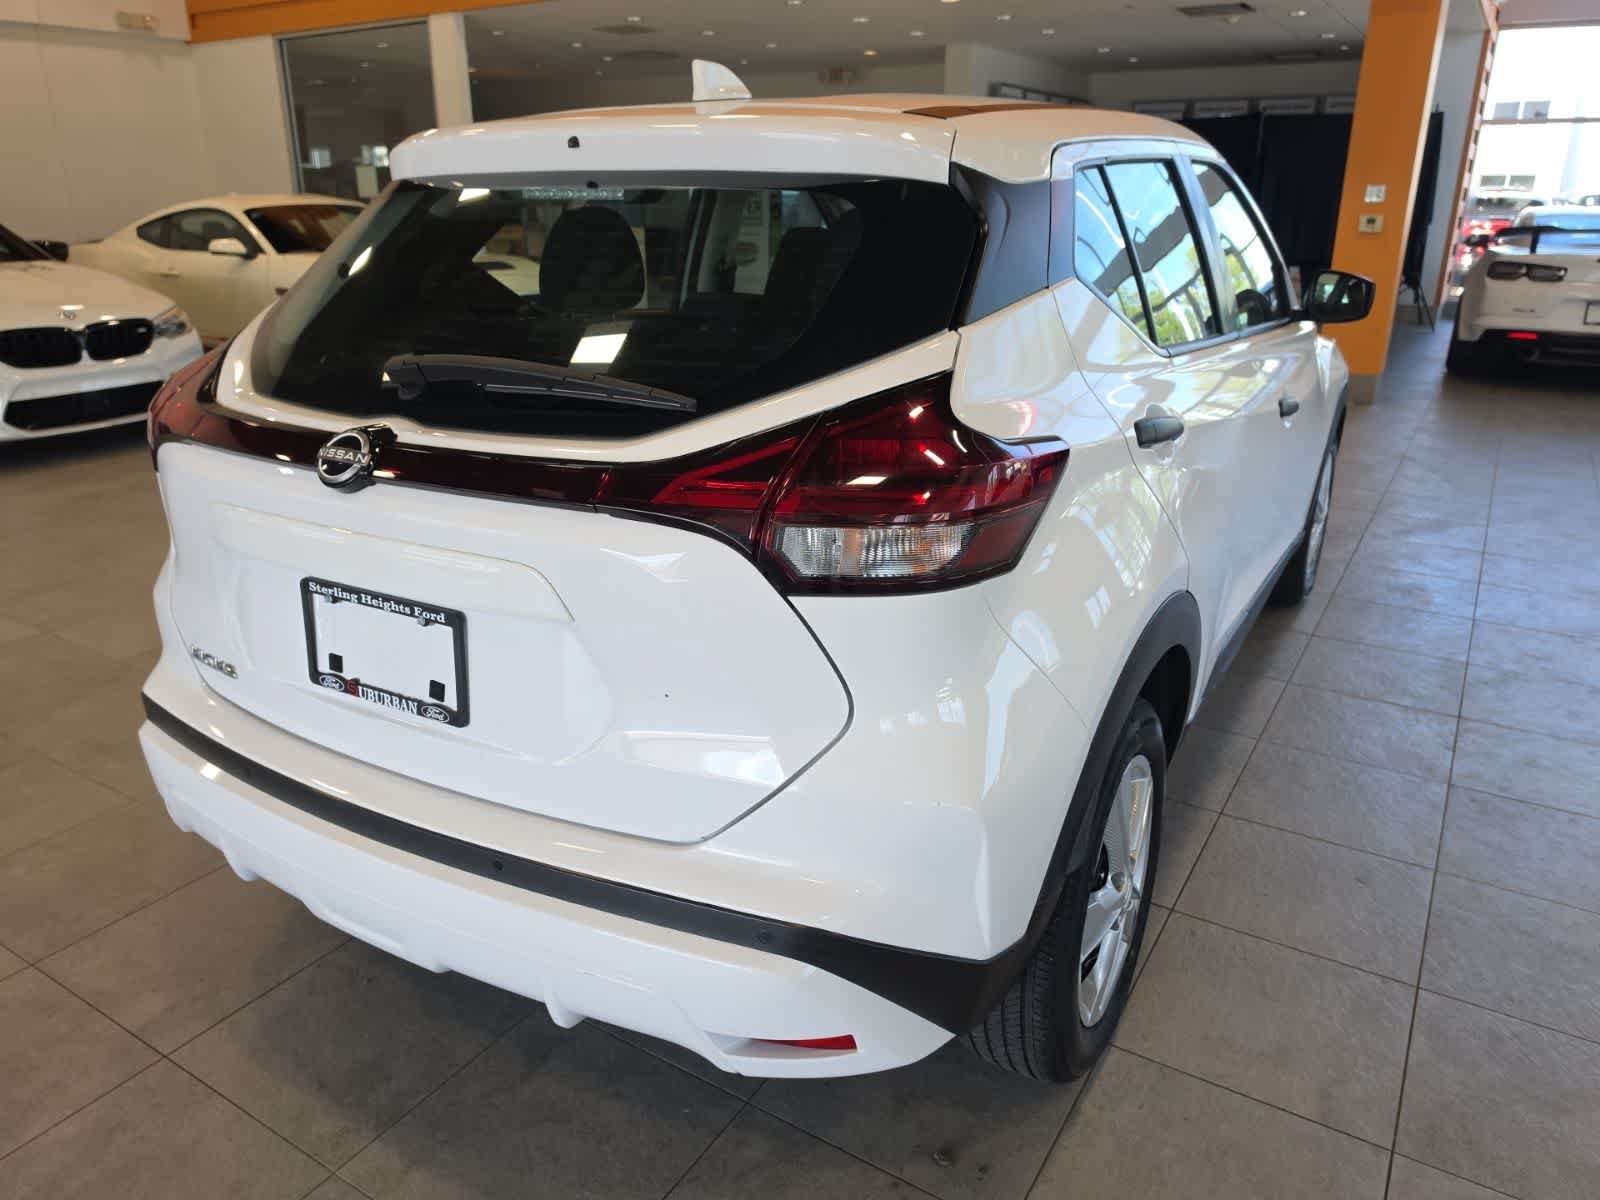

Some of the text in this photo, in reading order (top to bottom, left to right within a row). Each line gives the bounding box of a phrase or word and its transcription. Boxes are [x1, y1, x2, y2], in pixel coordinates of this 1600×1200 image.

[319, 448, 369, 464] NISSAN
[308, 581, 446, 624] Sterling Heights Ford
[346, 678, 418, 715] SUBURBAN
